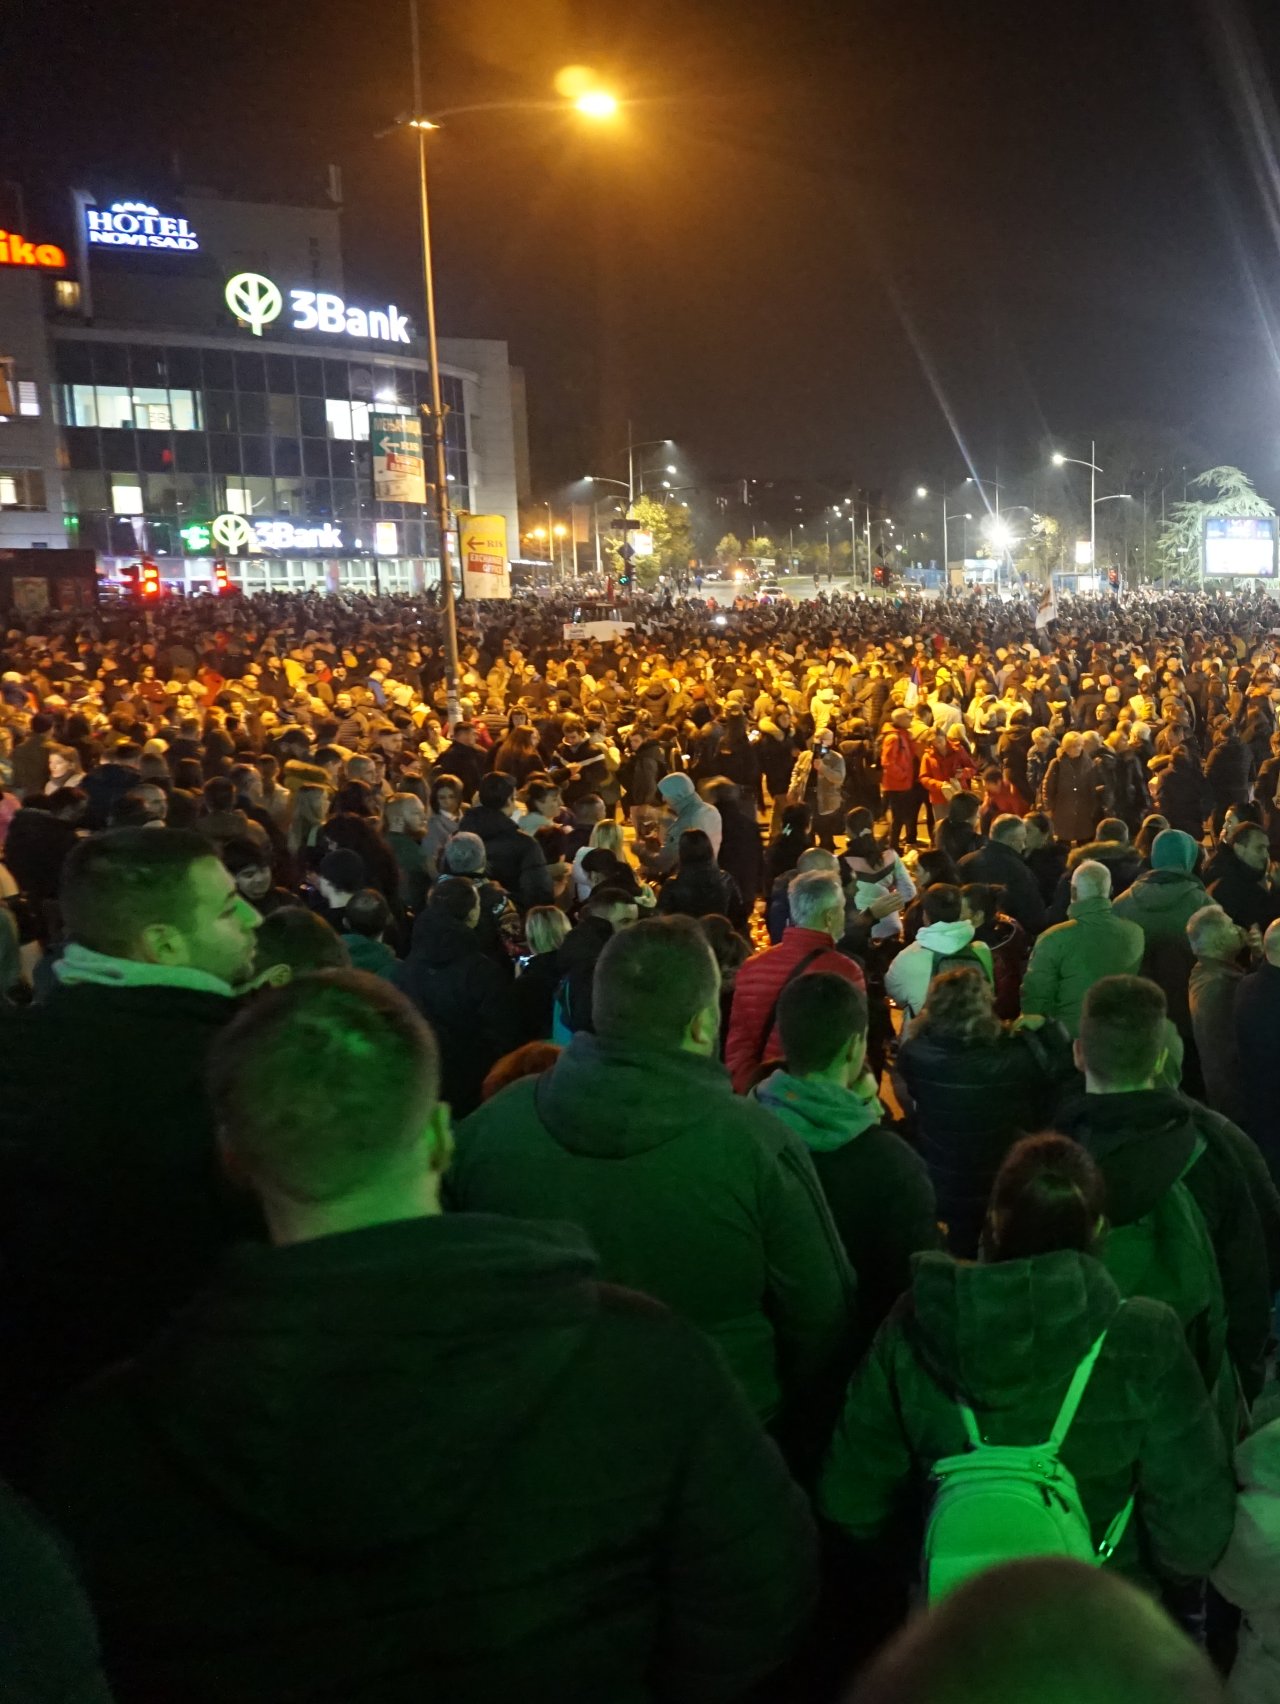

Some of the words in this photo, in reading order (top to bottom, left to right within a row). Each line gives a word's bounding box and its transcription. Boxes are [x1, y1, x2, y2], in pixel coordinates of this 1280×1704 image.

[87, 211, 197, 238] HOTEL
[89, 231, 148, 246] NOVI
[149, 235, 199, 250] SAD
[290, 289, 411, 344] 3Bank
[254, 522, 343, 548] 3Bank
